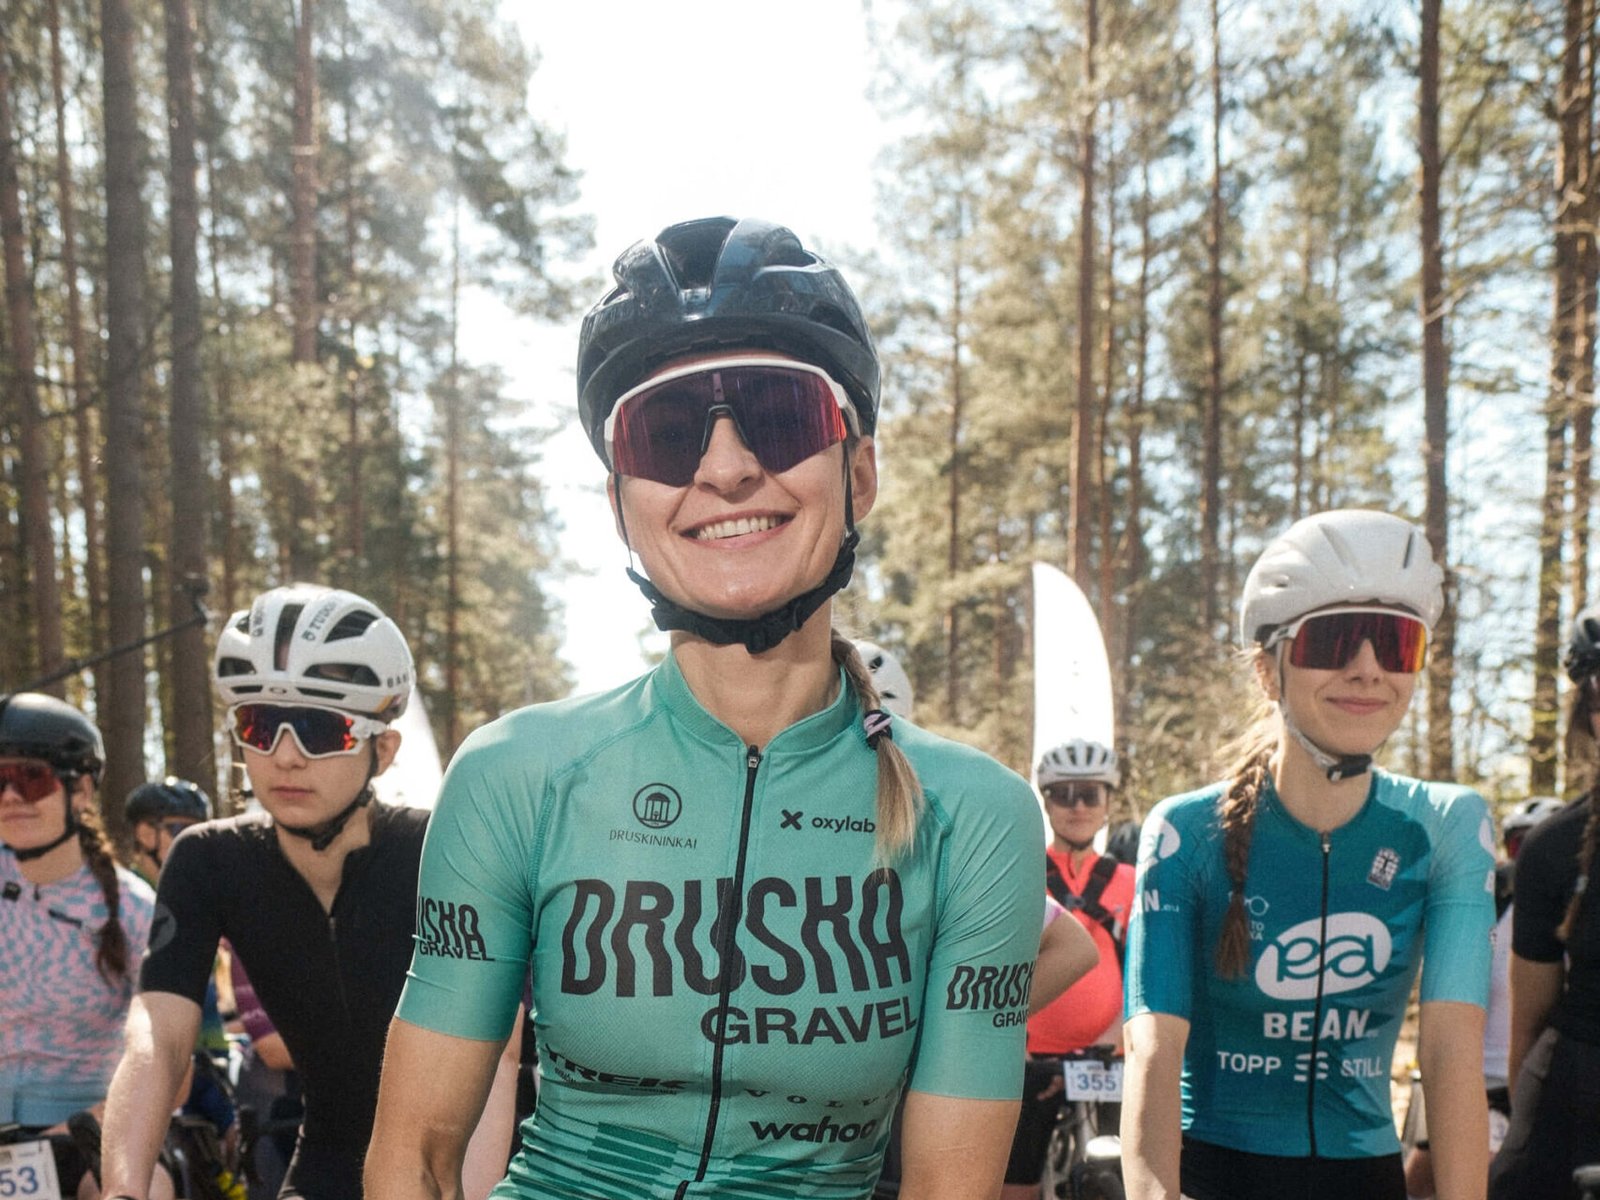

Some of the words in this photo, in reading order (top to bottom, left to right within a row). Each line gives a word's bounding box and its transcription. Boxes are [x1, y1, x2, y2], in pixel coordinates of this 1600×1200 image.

[811, 816, 877, 833] oxylab
[609, 829, 698, 850] DRUSKININKAI
[561, 867, 913, 998] DRUSKA
[946, 961, 1036, 1010] DRUSK
[700, 996, 918, 1045] GRAVEL
[1217, 1051, 1282, 1075] TOPP
[1340, 1057, 1383, 1078] STILL
[1077, 1073, 1116, 1091] 355
[748, 1115, 877, 1143] wahoo
[0, 1166, 38, 1197] 53
